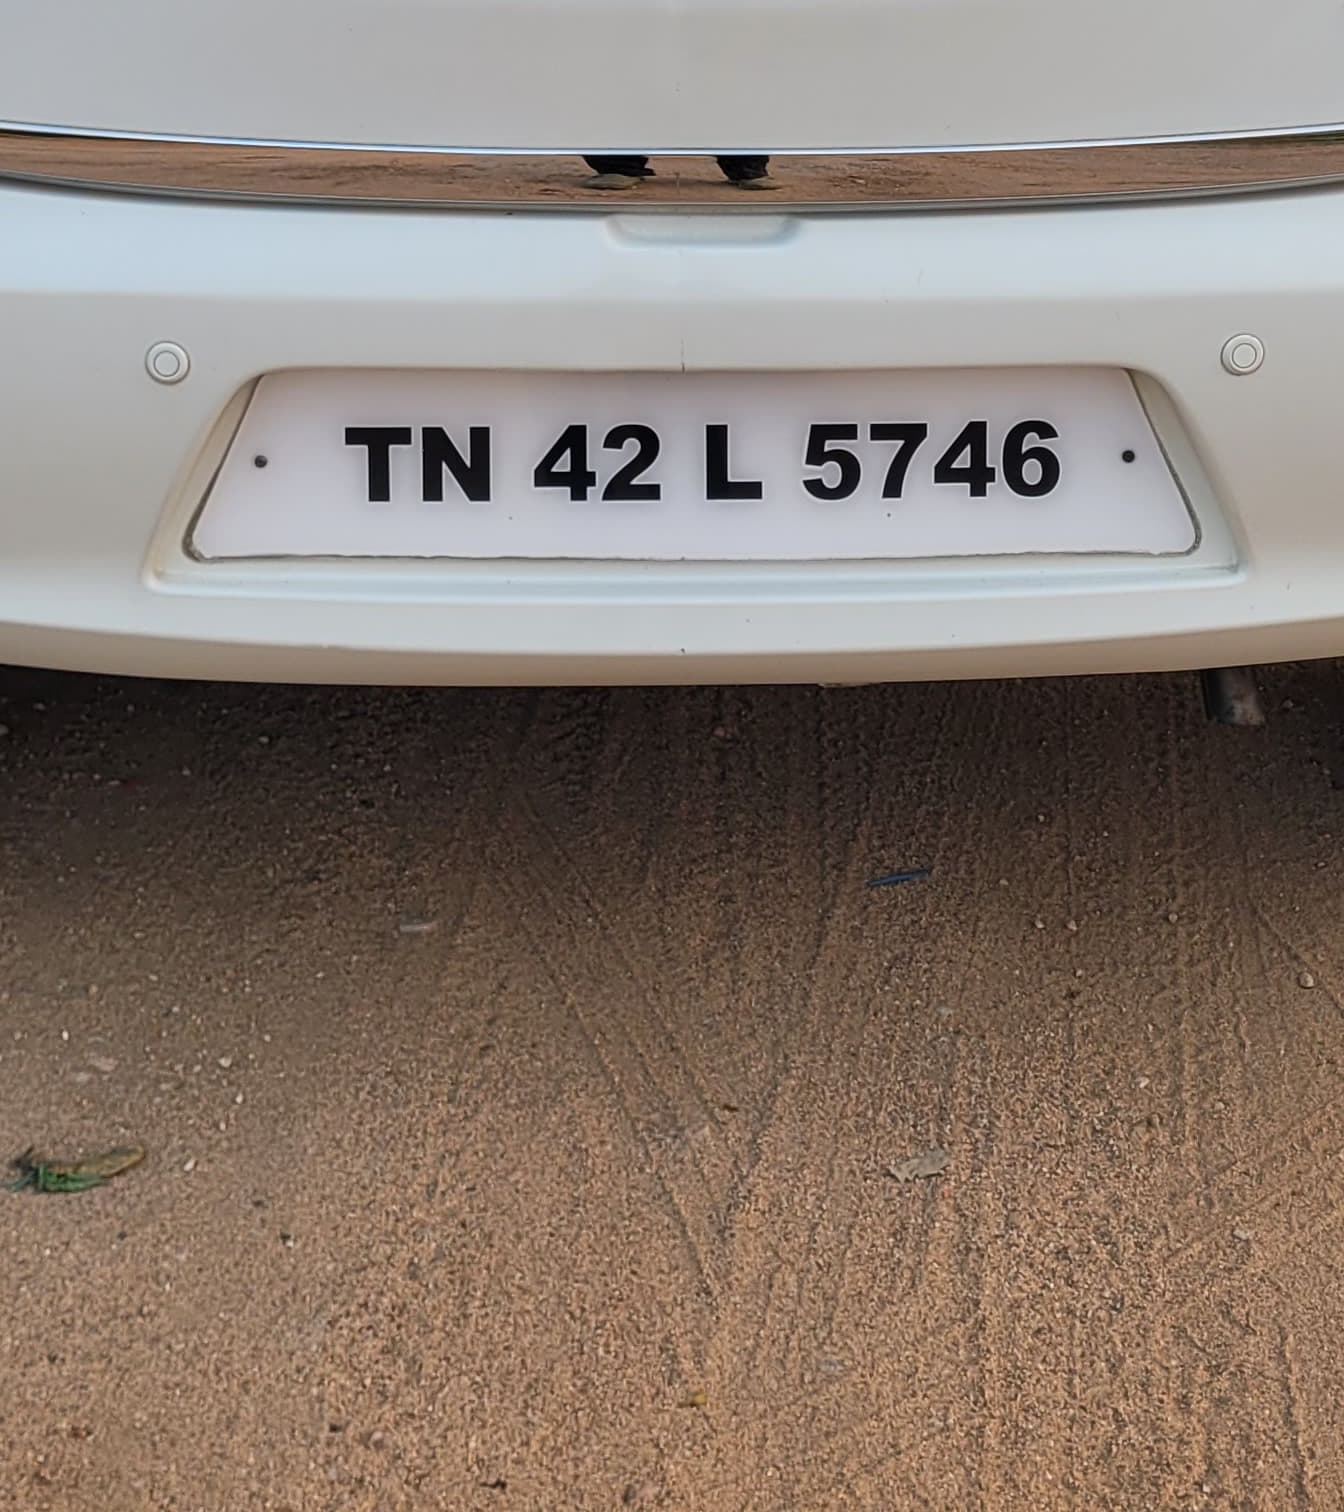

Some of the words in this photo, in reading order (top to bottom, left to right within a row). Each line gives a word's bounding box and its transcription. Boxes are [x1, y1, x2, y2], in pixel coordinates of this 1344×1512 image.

[344, 425, 492, 502] TN
[532, 423, 662, 502] 42
[704, 423, 764, 501] L
[800, 419, 1062, 501] 5746
